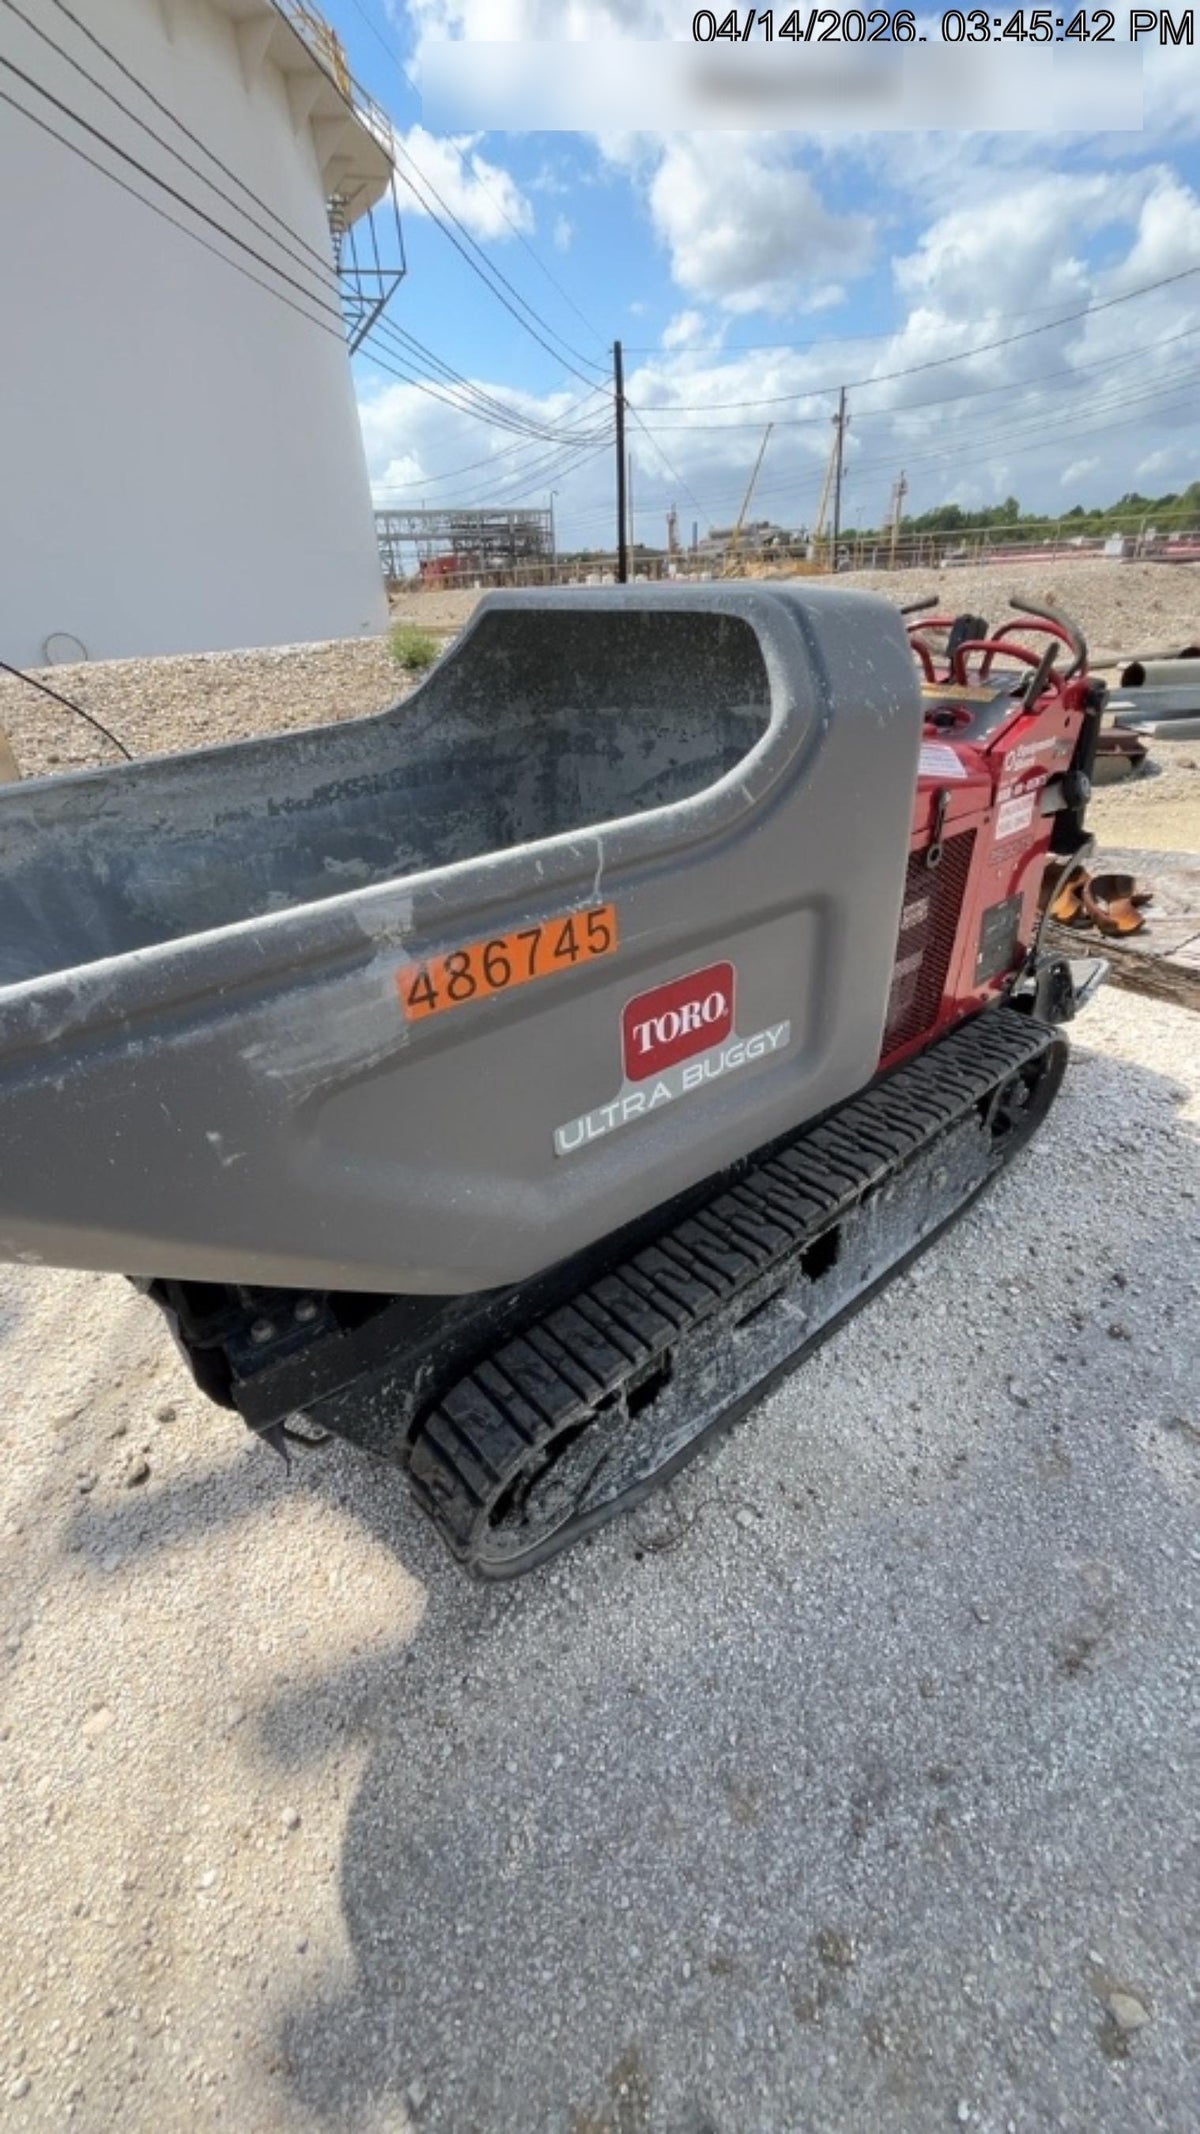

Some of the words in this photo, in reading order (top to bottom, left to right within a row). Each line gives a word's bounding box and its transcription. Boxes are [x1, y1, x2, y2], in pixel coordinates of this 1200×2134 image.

[407, 908, 611, 1010] 486745
[632, 991, 727, 1054] TORO
[557, 1082, 673, 1151] ULTRA
[683, 1022, 788, 1091] BUGGY
